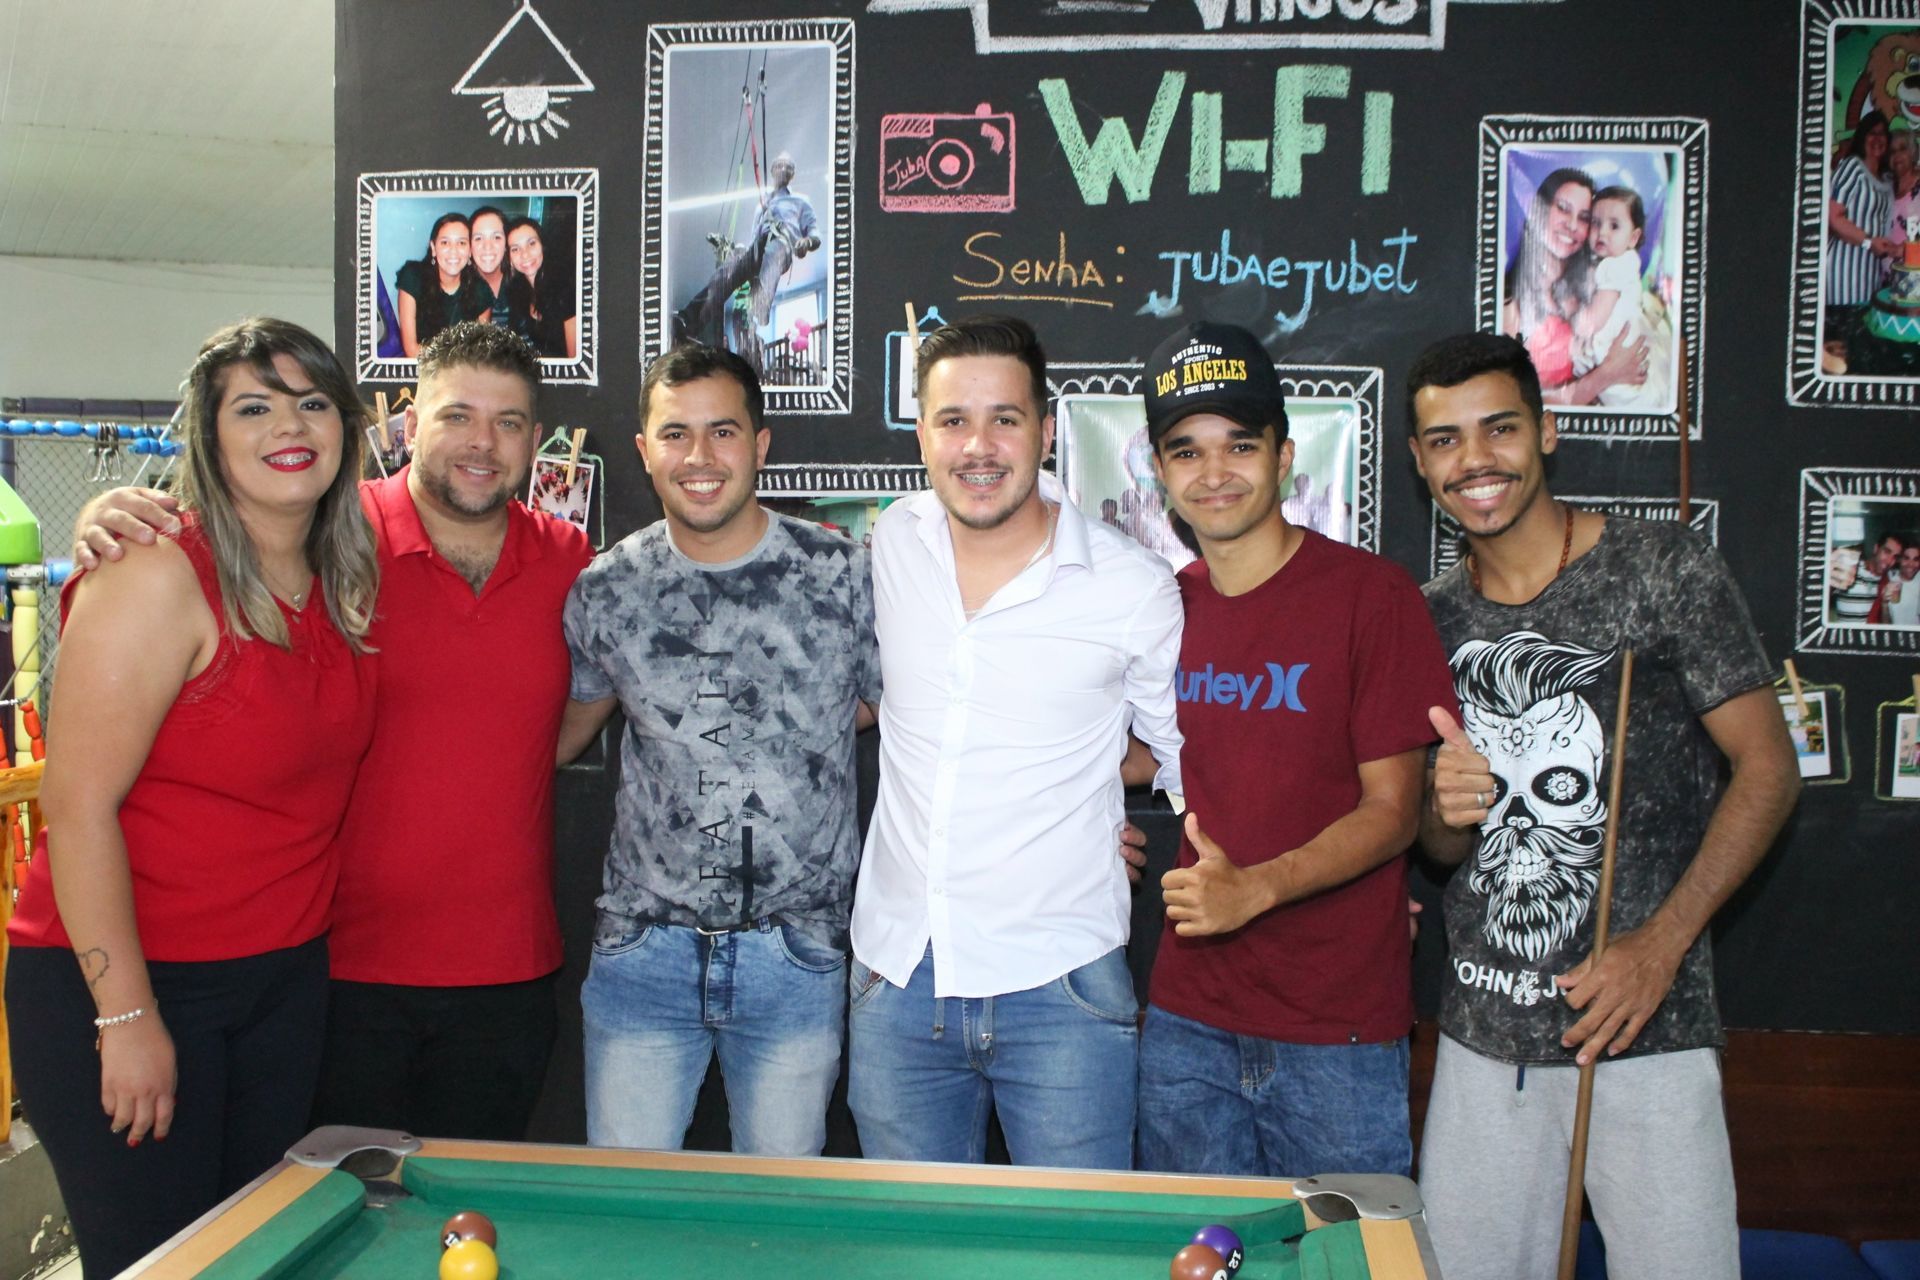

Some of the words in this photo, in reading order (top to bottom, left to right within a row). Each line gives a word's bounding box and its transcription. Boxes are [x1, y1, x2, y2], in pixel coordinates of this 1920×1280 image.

[1038, 65, 1394, 205] WI-FI
[1171, 344, 1223, 365] AUTHENTIC
[1156, 368, 1177, 397] LOS
[1182, 359, 1247, 386] ANGELES
[1184, 385, 1200, 395] SINCE
[1454, 958, 1514, 995] OHN
